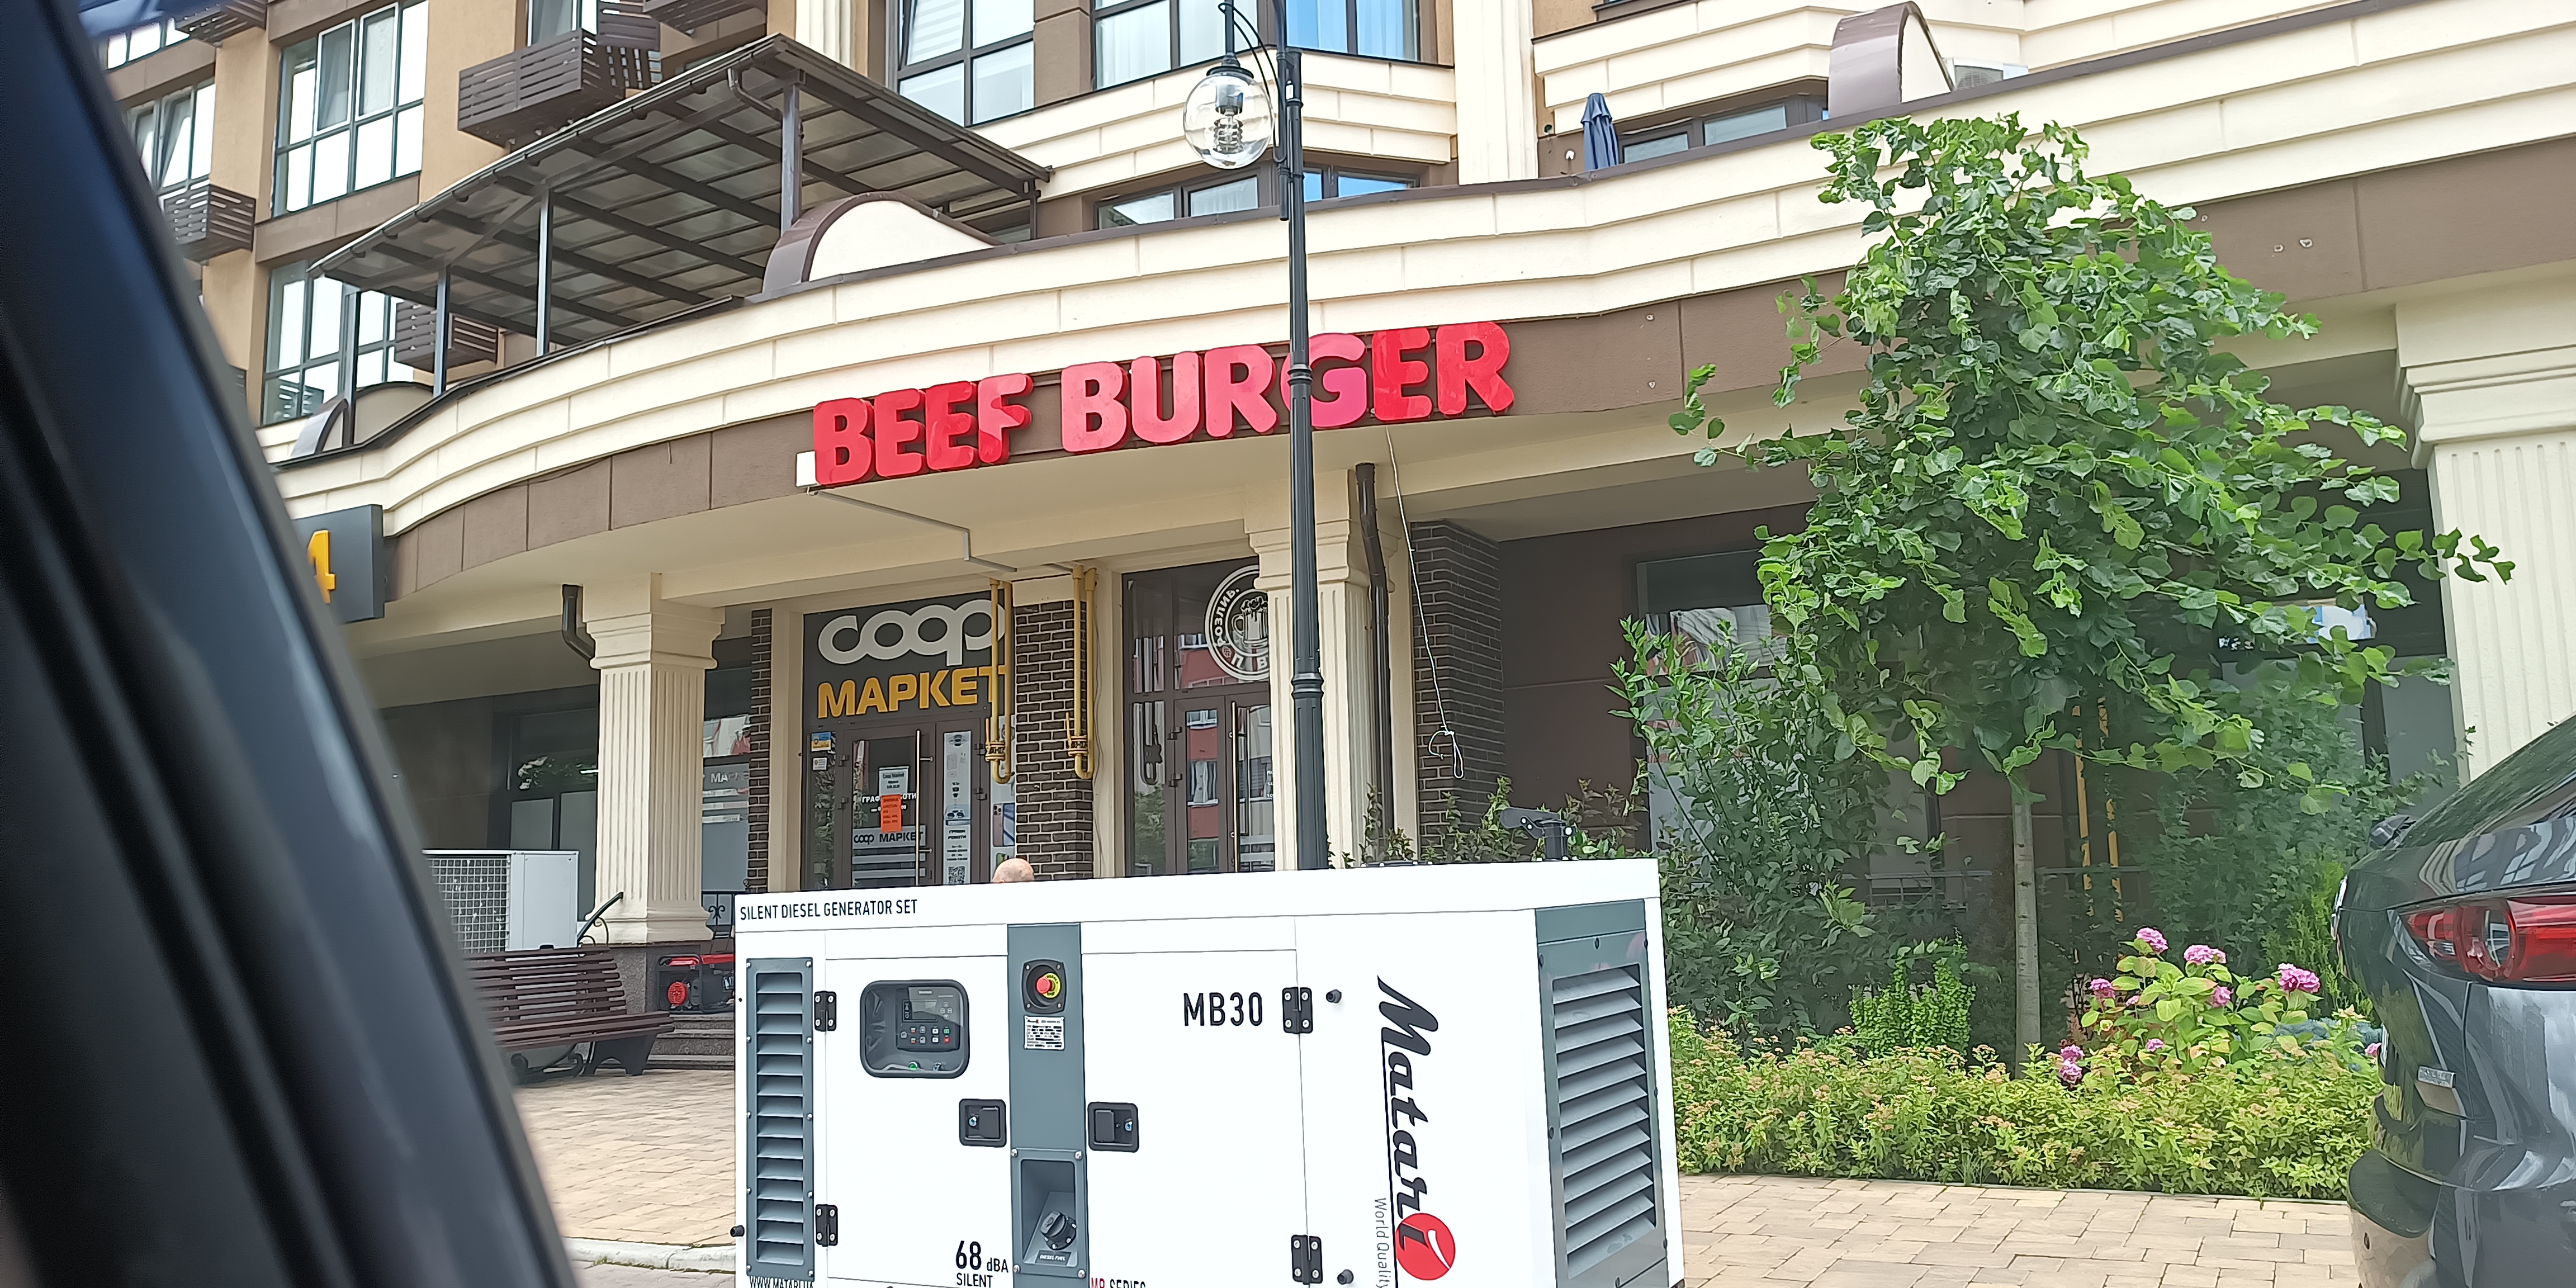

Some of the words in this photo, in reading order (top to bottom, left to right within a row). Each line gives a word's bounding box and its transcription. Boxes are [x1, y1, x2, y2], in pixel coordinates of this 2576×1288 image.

[813, 373, 1033, 485] BEEF
[1060, 321, 1514, 452] BURGER
[818, 665, 1006, 719] МАРКЕТ
[740, 905, 778, 921] SILENT
[782, 903, 821, 918] DIESEL
[824, 900, 892, 916] GENERATOR
[896, 899, 917, 914] SET
[1183, 992, 1263, 1026] MB30
[1377, 975, 1451, 1277] Matari
[1374, 1197, 1390, 1238] World
[955, 1240, 982, 1271] 68
[987, 1257, 1009, 1273] dBA
[1376, 1242, 1391, 1288] Quality
[956, 1272, 993, 1288] SILENT
